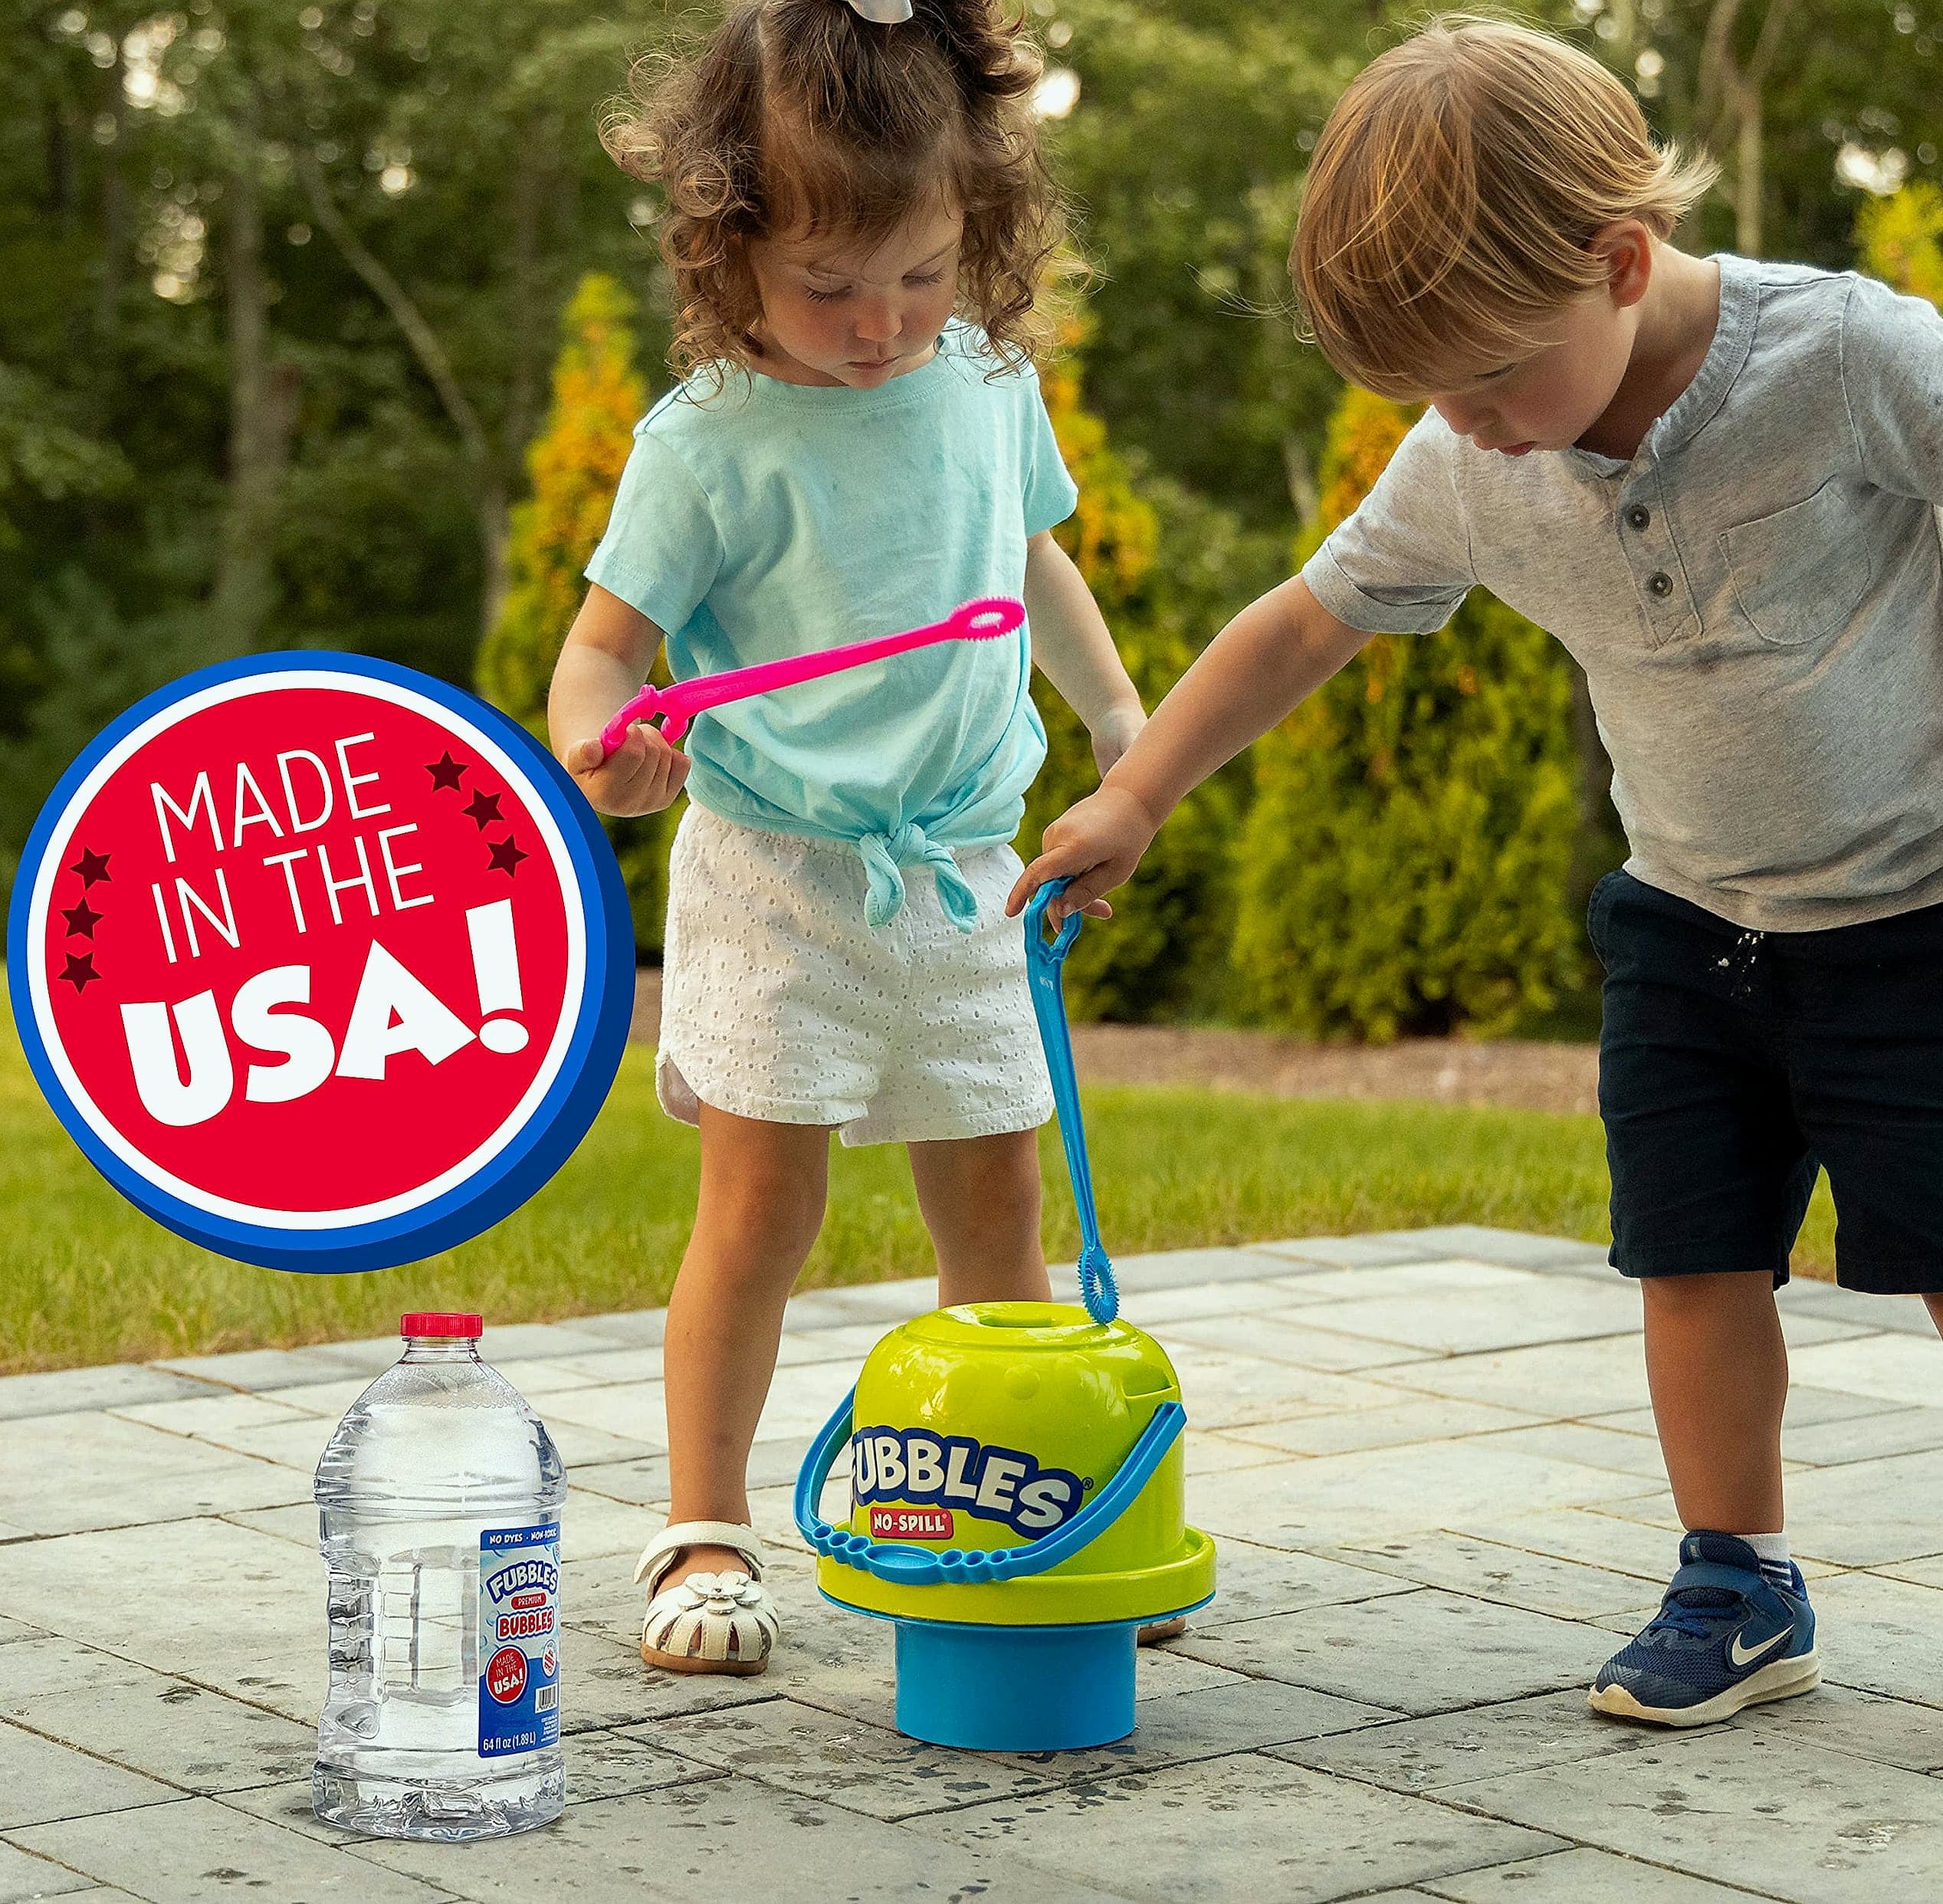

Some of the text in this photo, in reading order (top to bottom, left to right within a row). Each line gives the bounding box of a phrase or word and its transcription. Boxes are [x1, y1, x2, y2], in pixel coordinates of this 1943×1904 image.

[853, 1436, 1071, 1528] UBBLES
[874, 1512, 945, 1531] NO-SPILL
[489, 1535, 502, 1545] NO
[504, 1533, 523, 1543] DYES
[490, 1563, 557, 1598] FUBBLES
[518, 1594, 542, 1606] PREMIUM
[499, 1610, 553, 1636] BUBBLES
[496, 1652, 515, 1667] MADE
[496, 1661, 517, 1678] IN THE
[494, 1667, 523, 1695] USA!
[483, 1738, 494, 1751] 64
[503, 1738, 511, 1748] oz
